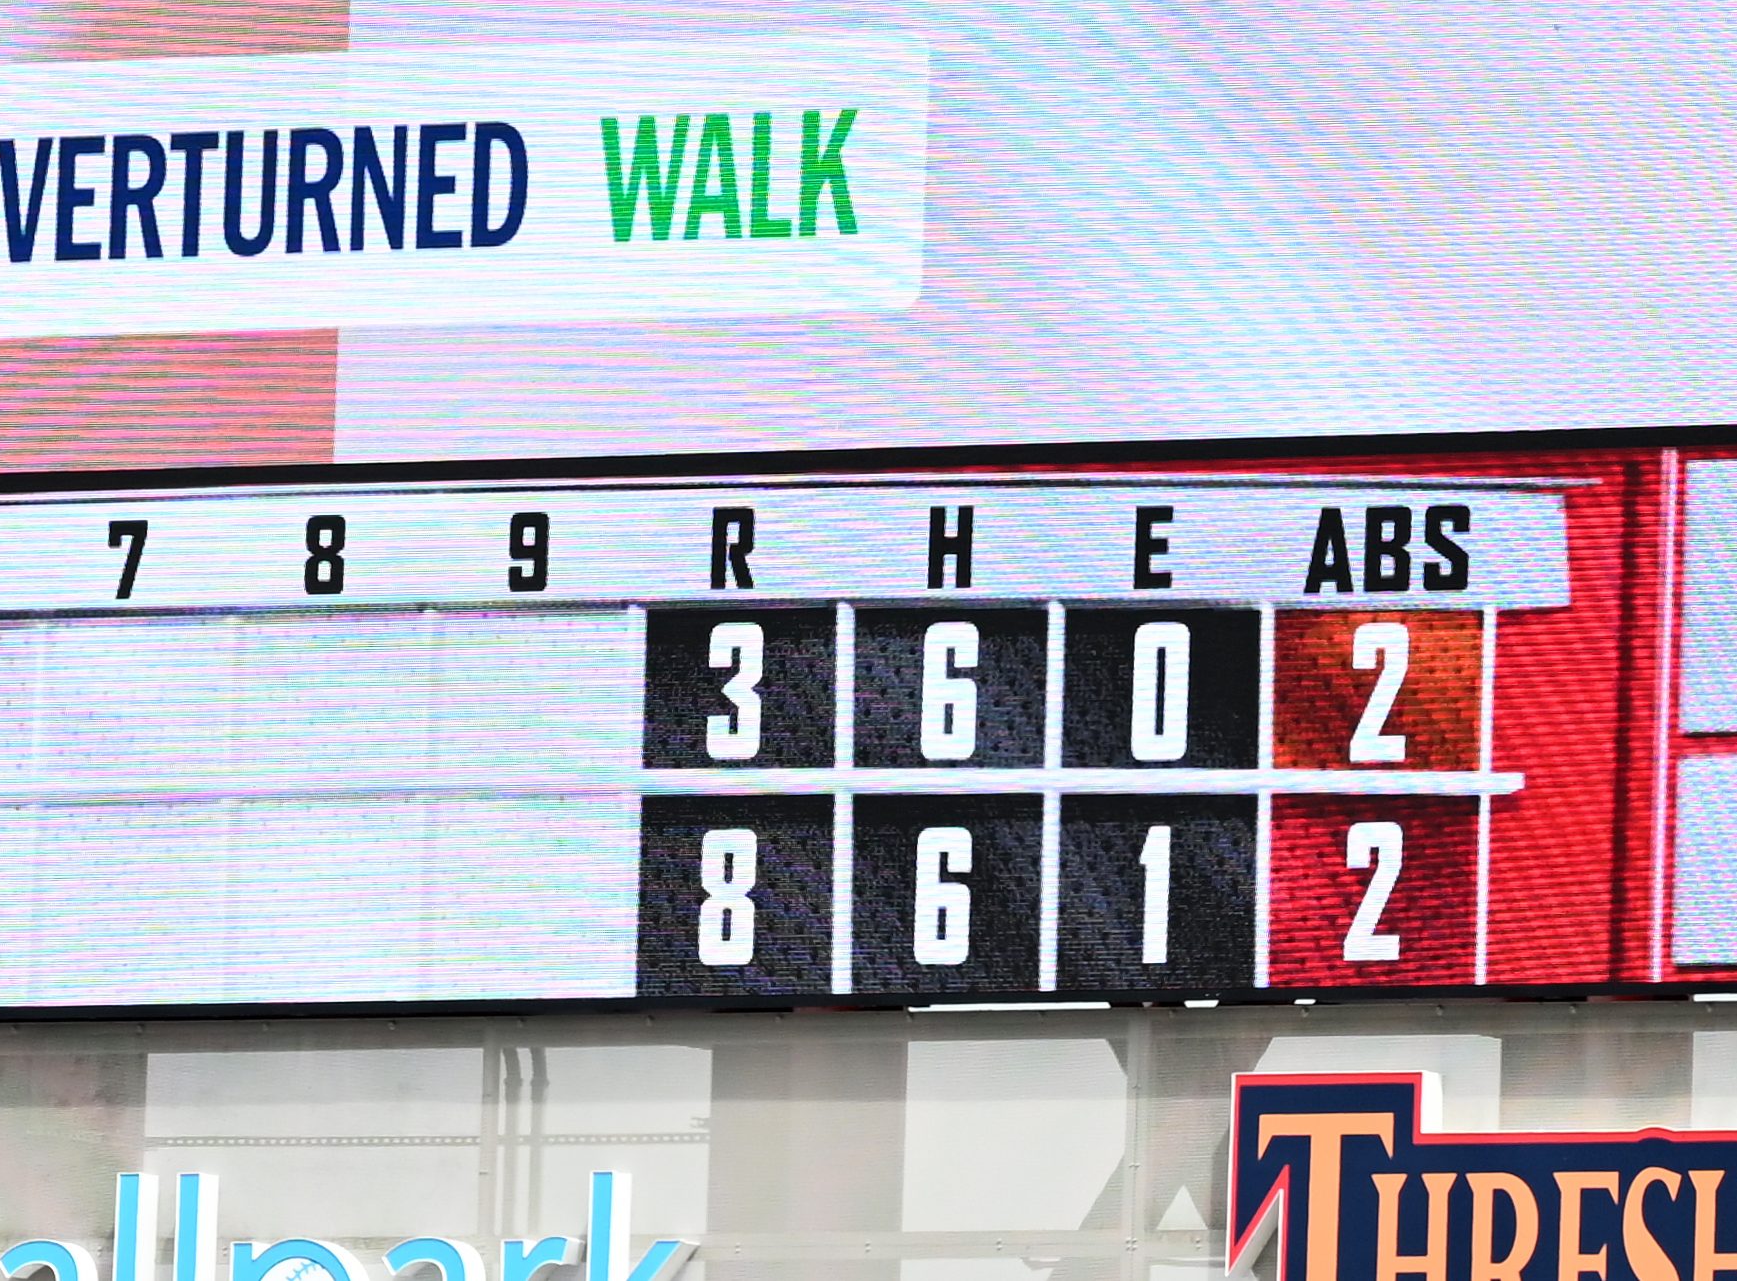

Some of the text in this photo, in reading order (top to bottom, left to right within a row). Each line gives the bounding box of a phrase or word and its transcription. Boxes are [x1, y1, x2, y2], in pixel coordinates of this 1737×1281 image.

[601, 108, 859, 243] WALK
[108, 520, 148, 599] 7
[305, 515, 346, 595] 8
[509, 512, 549, 591] 9
[712, 507, 755, 590] R
[929, 506, 974, 589] H
[1133, 505, 1174, 589] E
[1305, 504, 1470, 594] ABS
[706, 622, 764, 761] 3
[920, 622, 980, 761] 6
[1131, 622, 1191, 761] 0
[1350, 622, 1409, 763] 2
[698, 829, 757, 966] 8
[914, 826, 973, 965] 6
[1140, 825, 1170, 964] 1
[1343, 821, 1403, 962] 2
